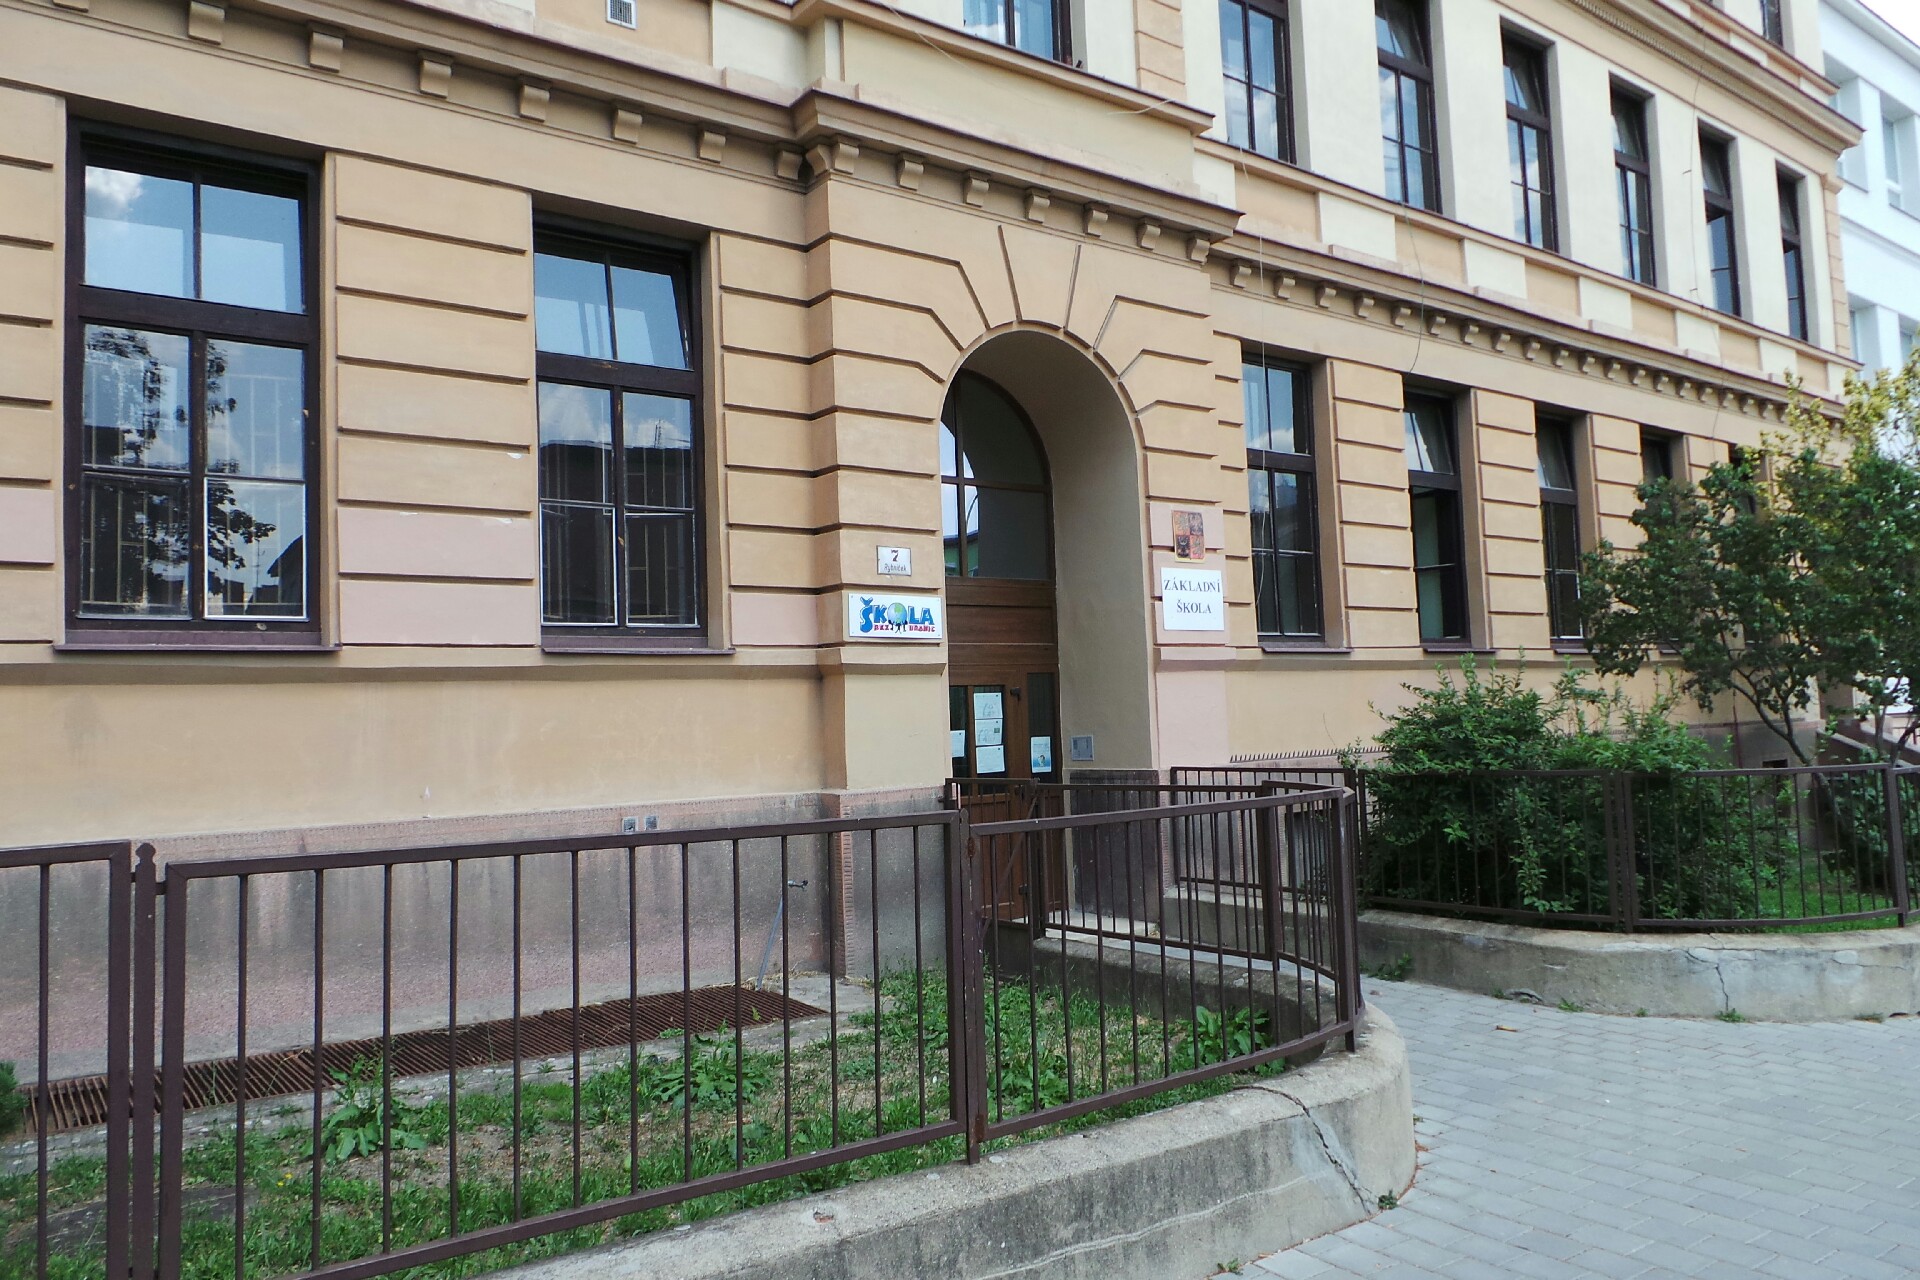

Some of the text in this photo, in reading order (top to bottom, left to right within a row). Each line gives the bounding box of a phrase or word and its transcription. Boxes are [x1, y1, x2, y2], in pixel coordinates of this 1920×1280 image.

[891, 549, 899, 562] 7
[1164, 577, 1220, 593] ZÁKLADNÍ
[860, 596, 935, 633] ŠKOLA
[1177, 600, 1212, 614] ŠKOLA
